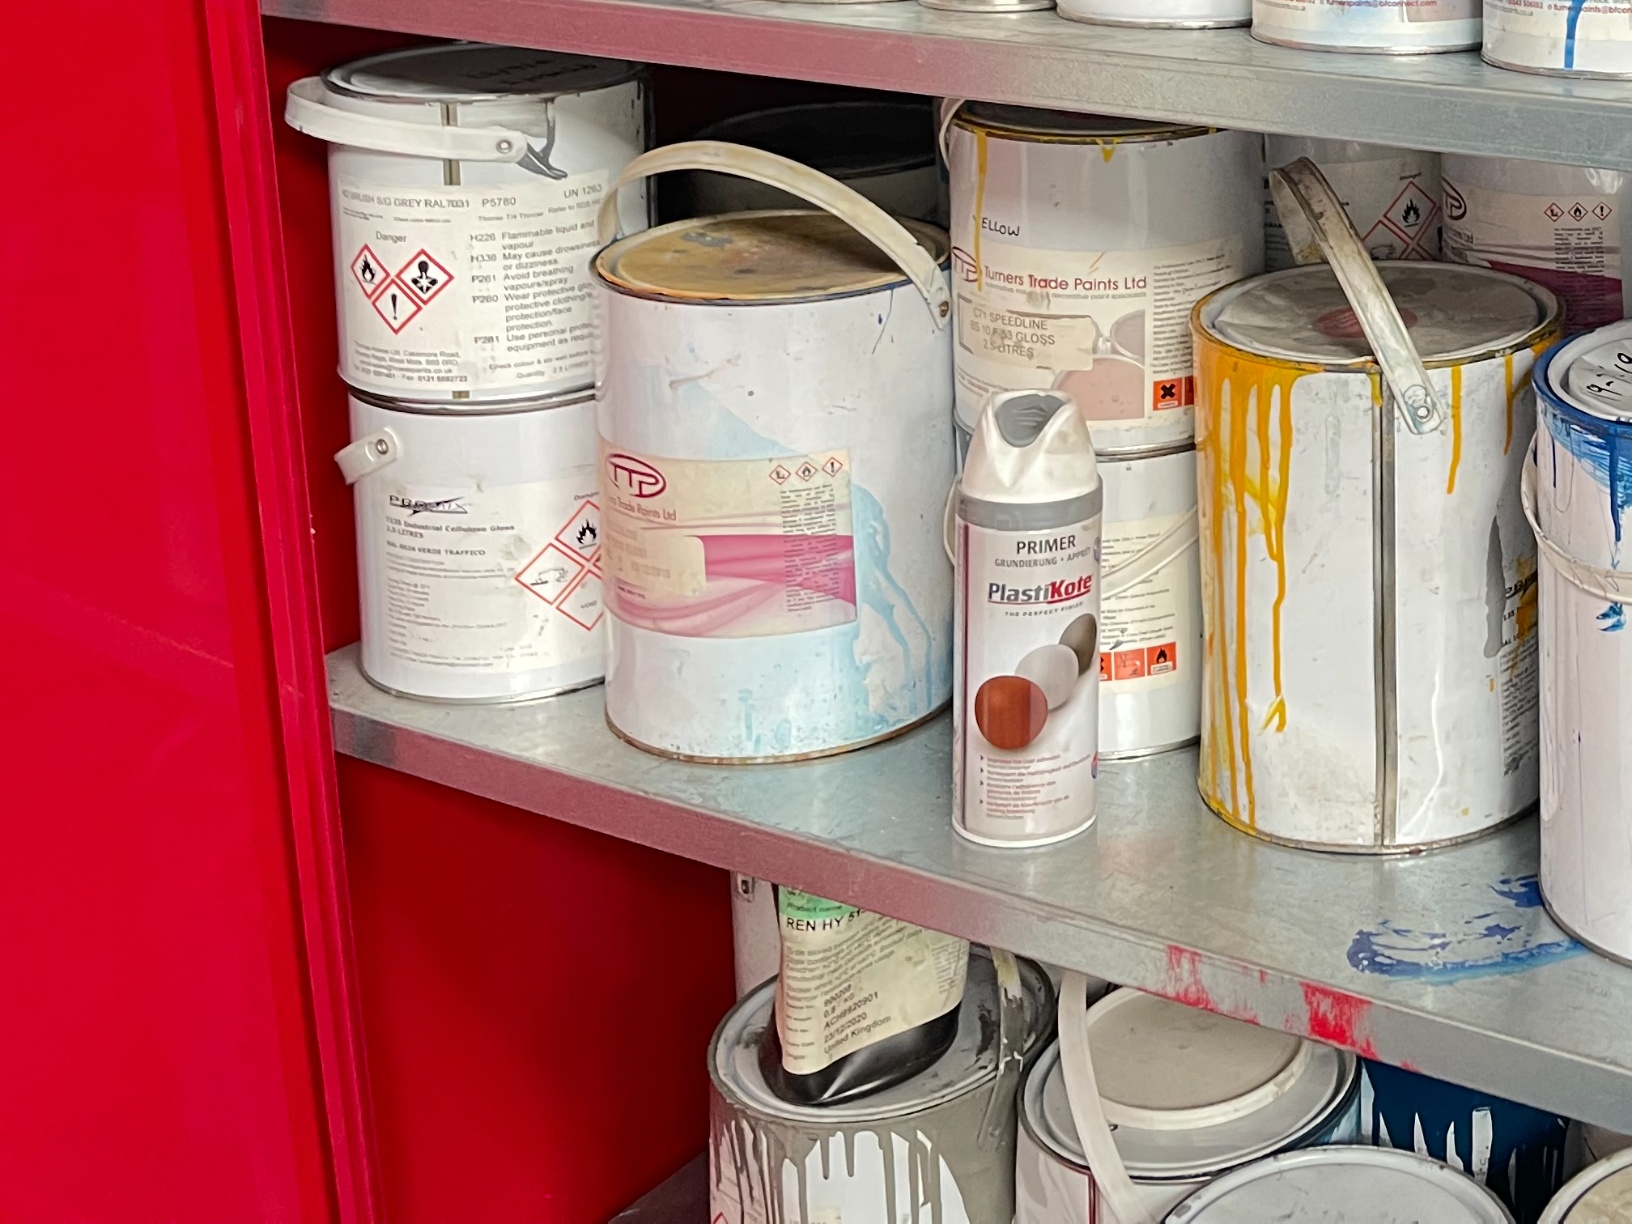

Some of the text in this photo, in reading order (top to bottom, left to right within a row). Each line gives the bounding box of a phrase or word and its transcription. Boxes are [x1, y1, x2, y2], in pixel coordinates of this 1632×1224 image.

[394, 198, 422, 207] GREY
[482, 189, 578, 207] P5780 UN
[376, 231, 407, 244] Danger
[502, 220, 595, 240] Flammable liquid and
[502, 241, 534, 251] vapour
[503, 249, 553, 261] May cause
[503, 265, 574, 281] Avoid breathing
[985, 265, 1146, 291] Turners Trade Paints Ltd
[504, 291, 530, 301] Wear
[989, 312, 1048, 330] SPEEDLINE
[507, 327, 567, 342] Use personal
[1016, 332, 1055, 345] GLOSS
[507, 335, 555, 352] equipment
[1016, 535, 1076, 554] PRIMER
[995, 557, 1057, 567] GRUNDIERUNG
[988, 575, 1092, 602] PlastiKote
[1023, 608, 1058, 616] PERFECT
[787, 918, 842, 931] REN HY
[851, 1016, 891, 1037] Kingdom
